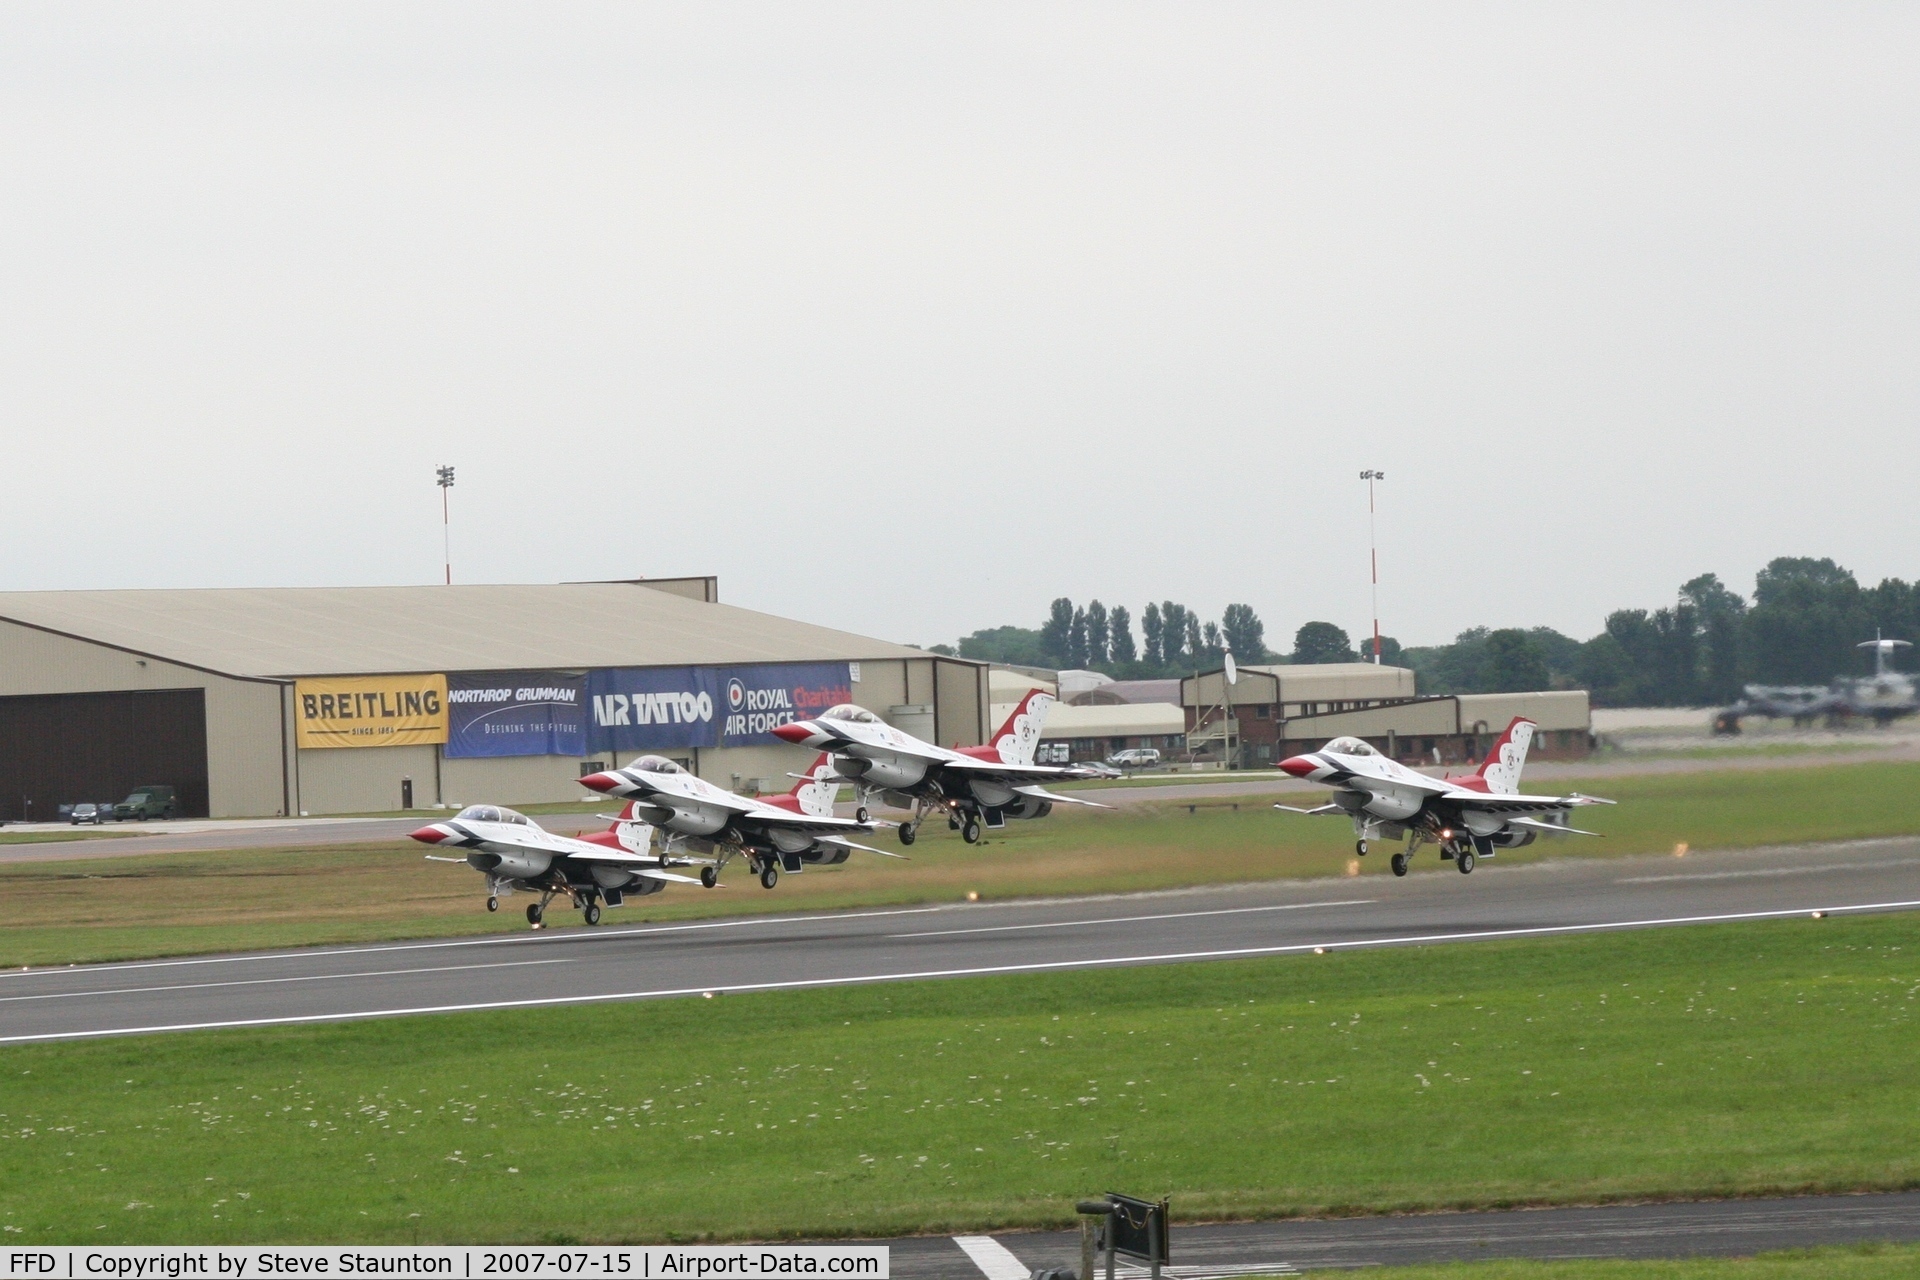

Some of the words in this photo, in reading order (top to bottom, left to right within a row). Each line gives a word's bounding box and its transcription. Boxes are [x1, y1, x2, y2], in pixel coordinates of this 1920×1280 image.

[303, 690, 441, 719] BREITLING
[448, 689, 512, 703] NORTHROP
[515, 687, 576, 701] GRUMMAN
[747, 688, 792, 710] ROYAL
[593, 694, 631, 727] AIR
[632, 691, 713, 725] TATTOO
[724, 715, 747, 736] AIR
